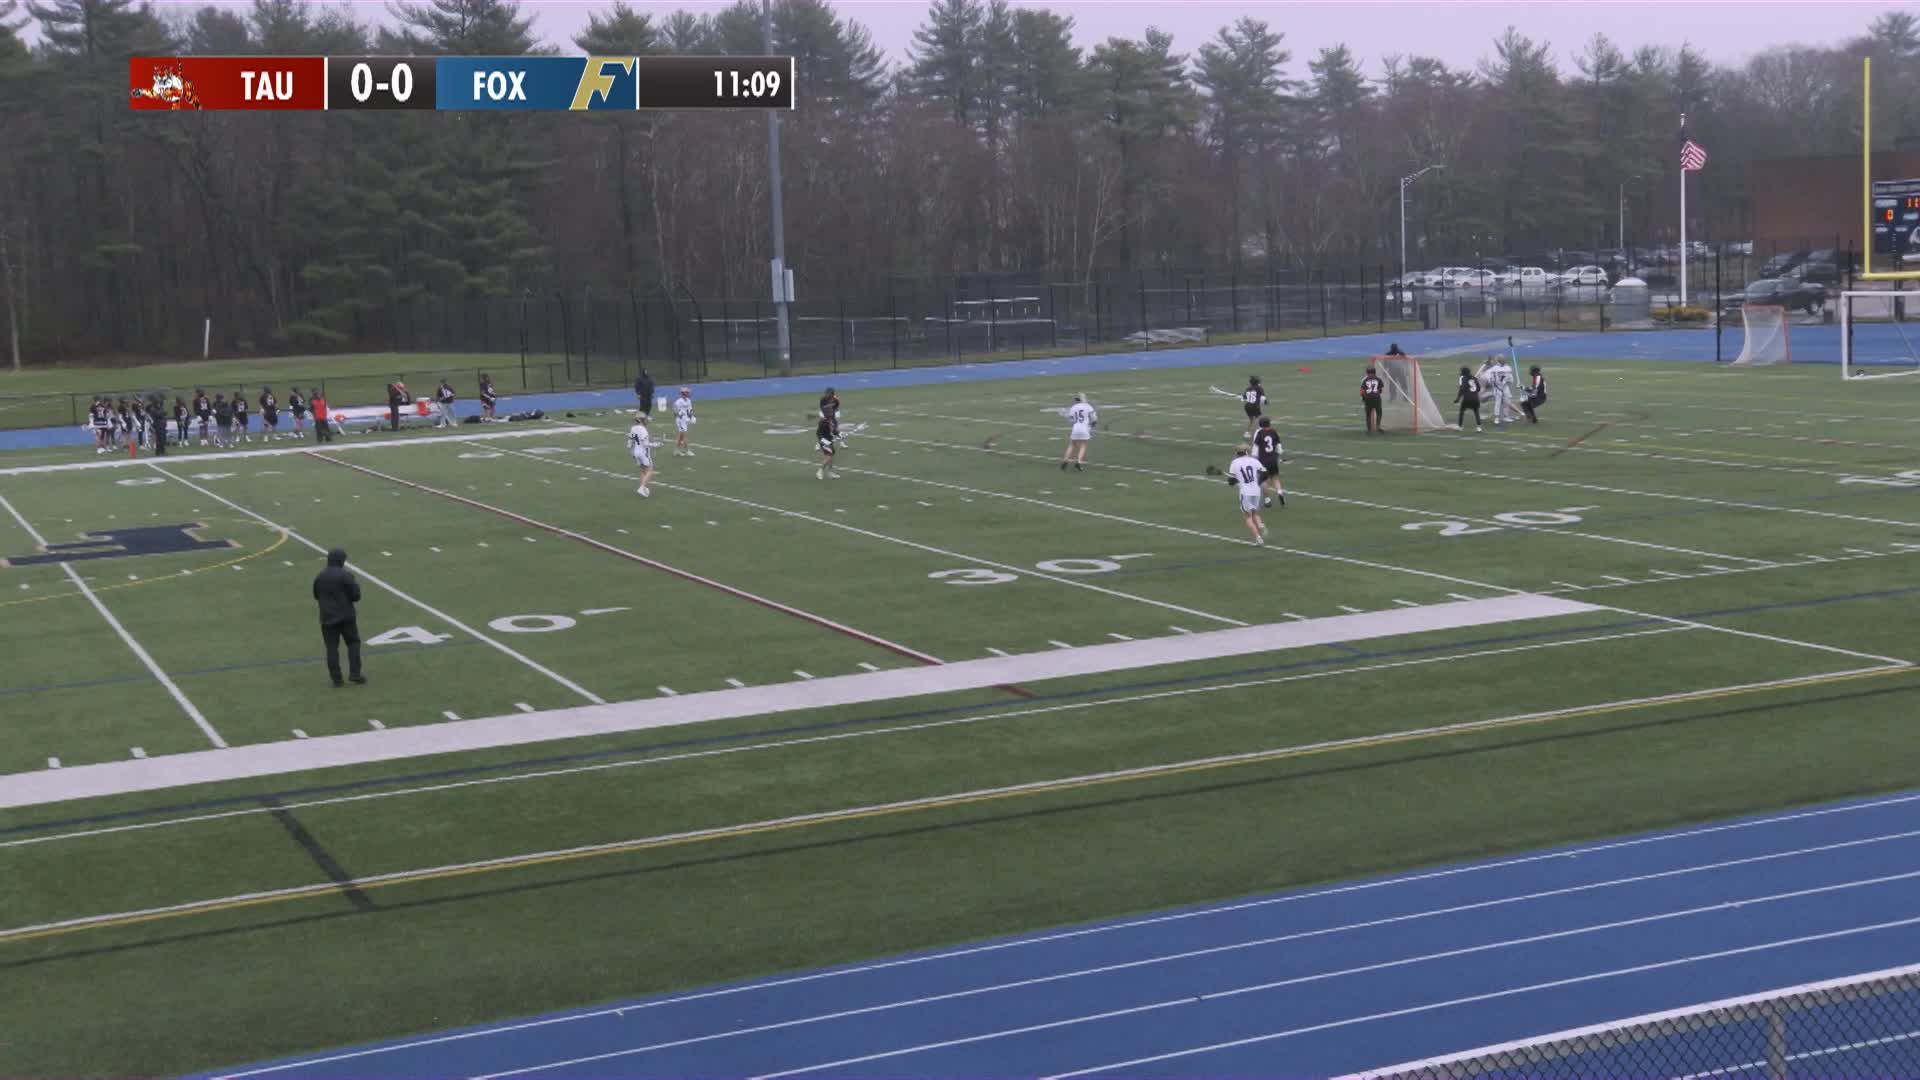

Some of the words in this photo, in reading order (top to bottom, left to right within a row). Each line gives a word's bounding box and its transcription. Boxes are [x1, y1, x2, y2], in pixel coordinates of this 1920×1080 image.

[1264, 435, 1274, 453] 3
[1240, 465, 1255, 484] 10
[1401, 511, 1584, 536] 20
[927, 558, 1122, 584] 30
[364, 615, 577, 646] 40
